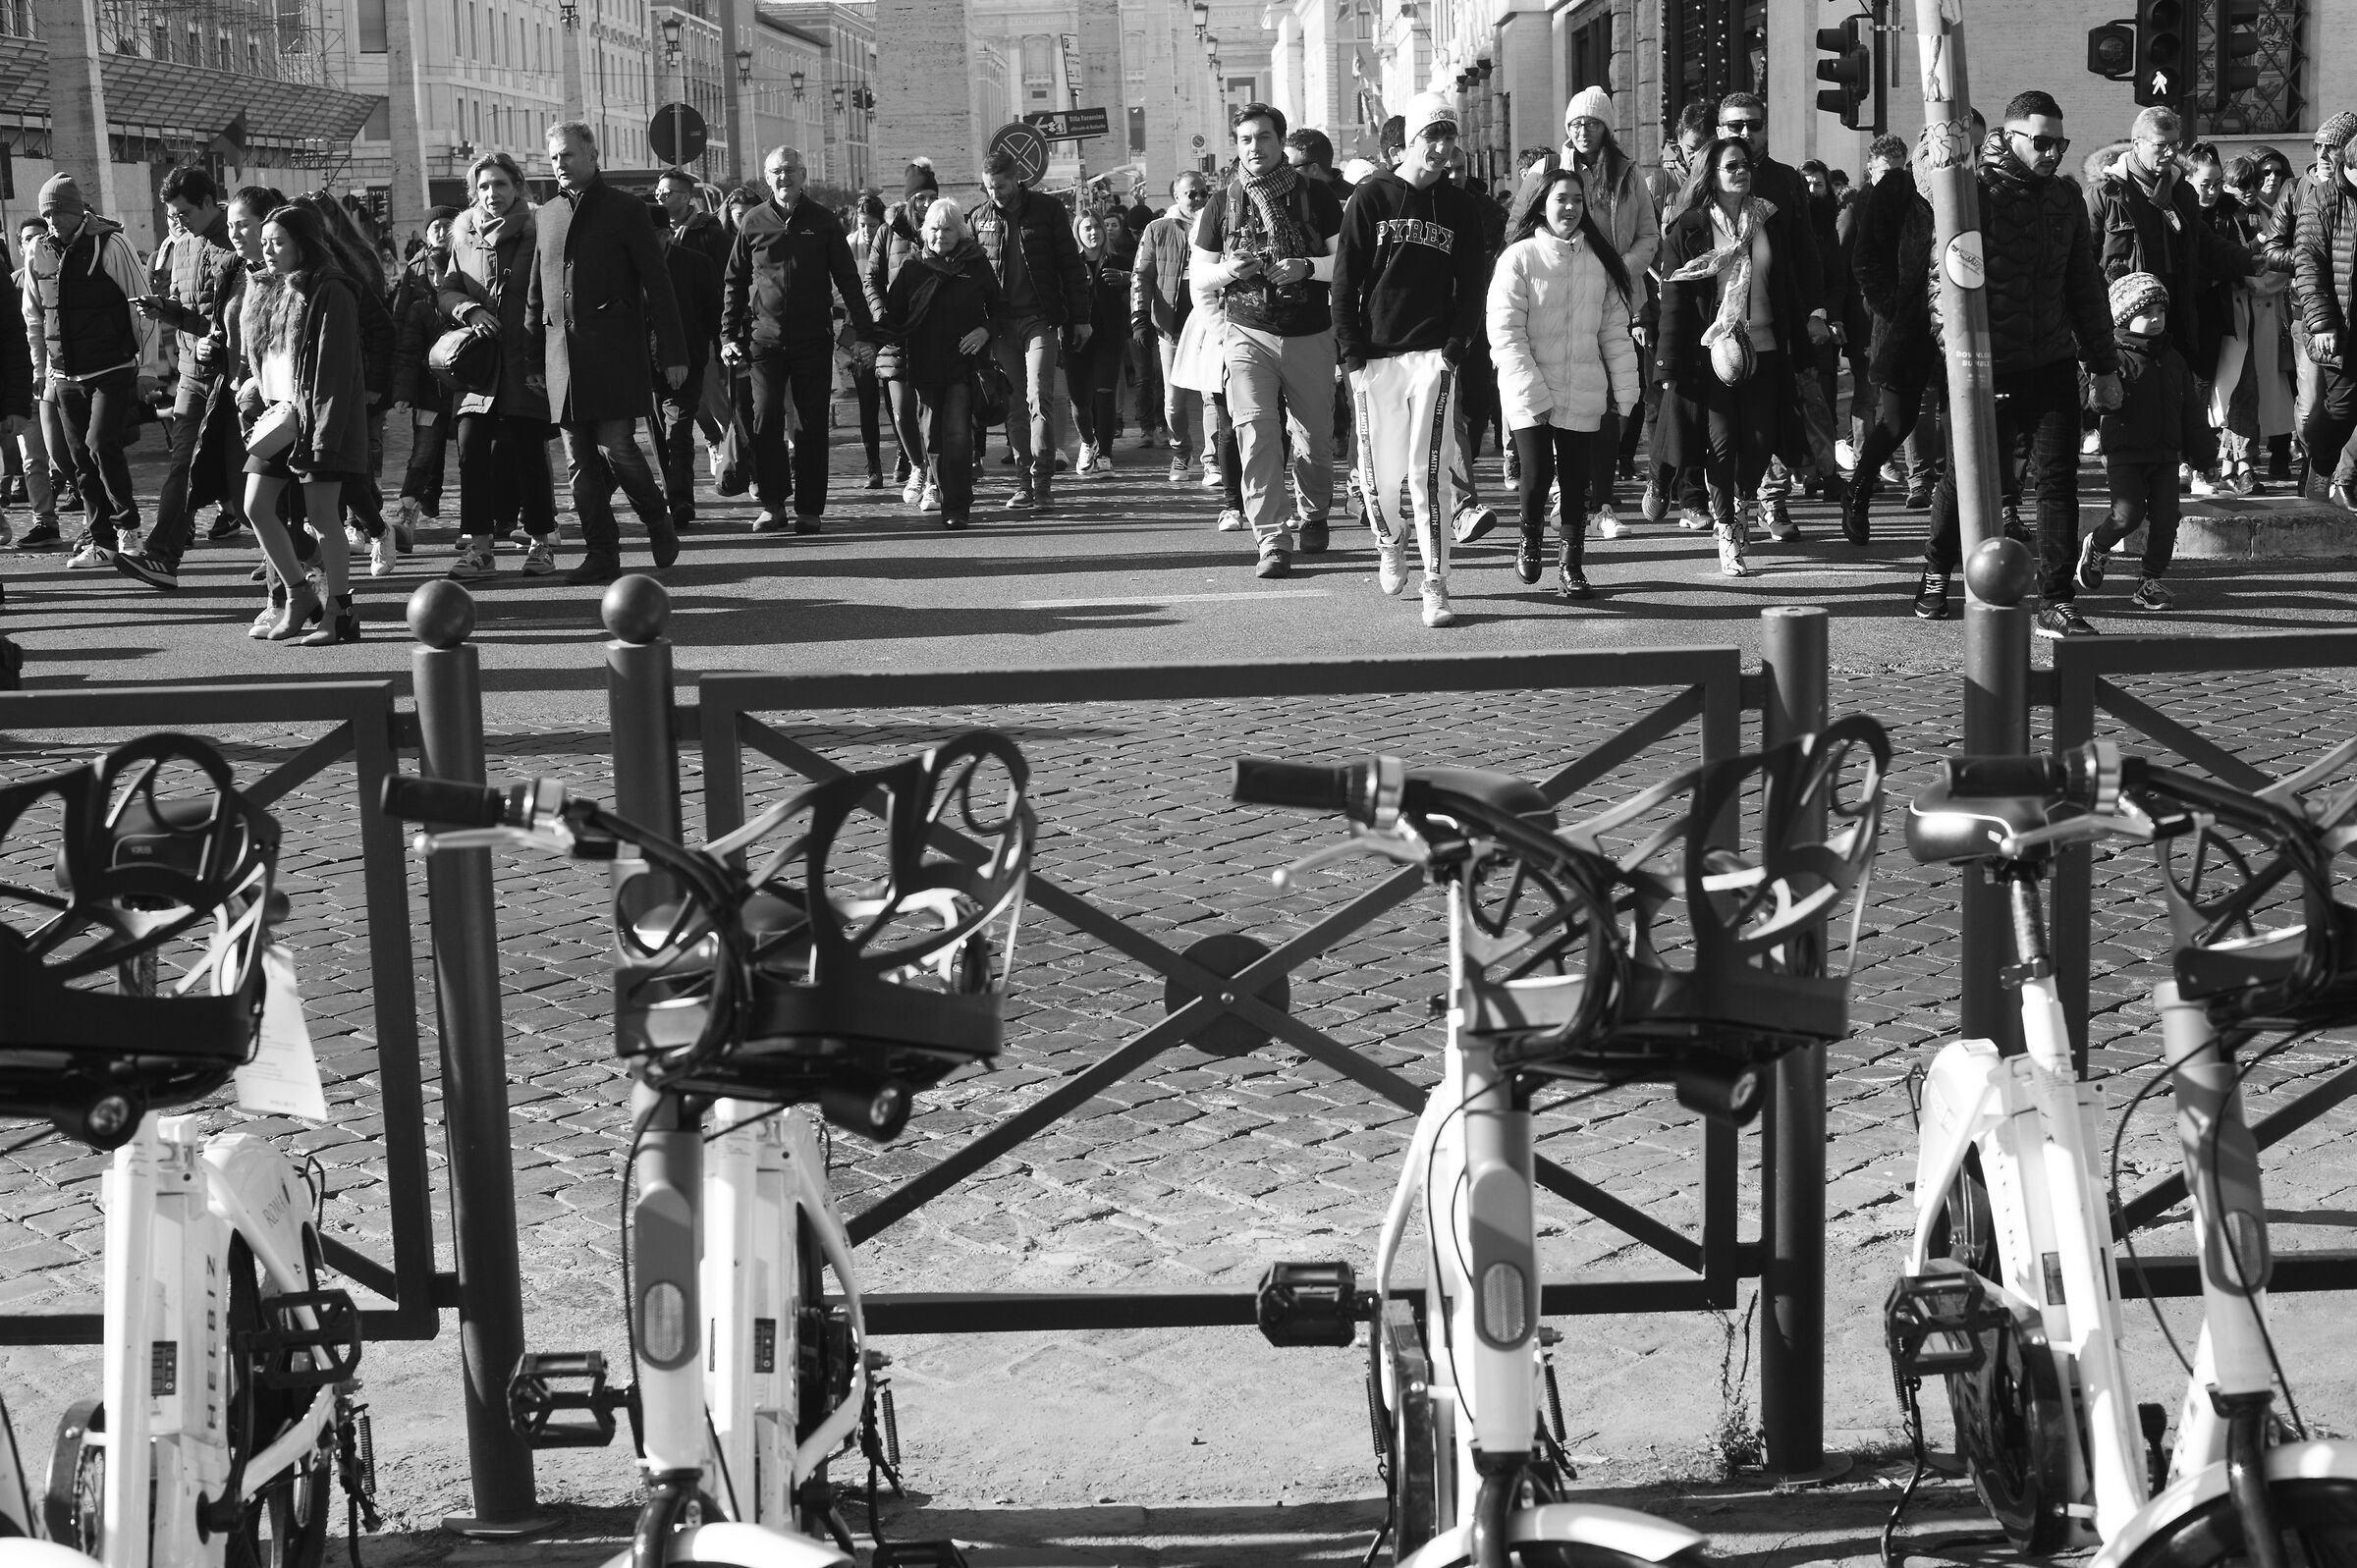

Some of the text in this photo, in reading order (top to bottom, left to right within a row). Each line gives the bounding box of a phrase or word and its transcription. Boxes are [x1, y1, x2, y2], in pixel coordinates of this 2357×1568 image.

[1376, 219, 1454, 255] PYREX
[1436, 392, 1448, 415] SMITH
[1359, 410, 1368, 435] SMITH
[1430, 450, 1439, 474] SMITH
[1430, 504, 1439, 525] SMITH
[205, 1254, 217, 1430] HELBIZ
